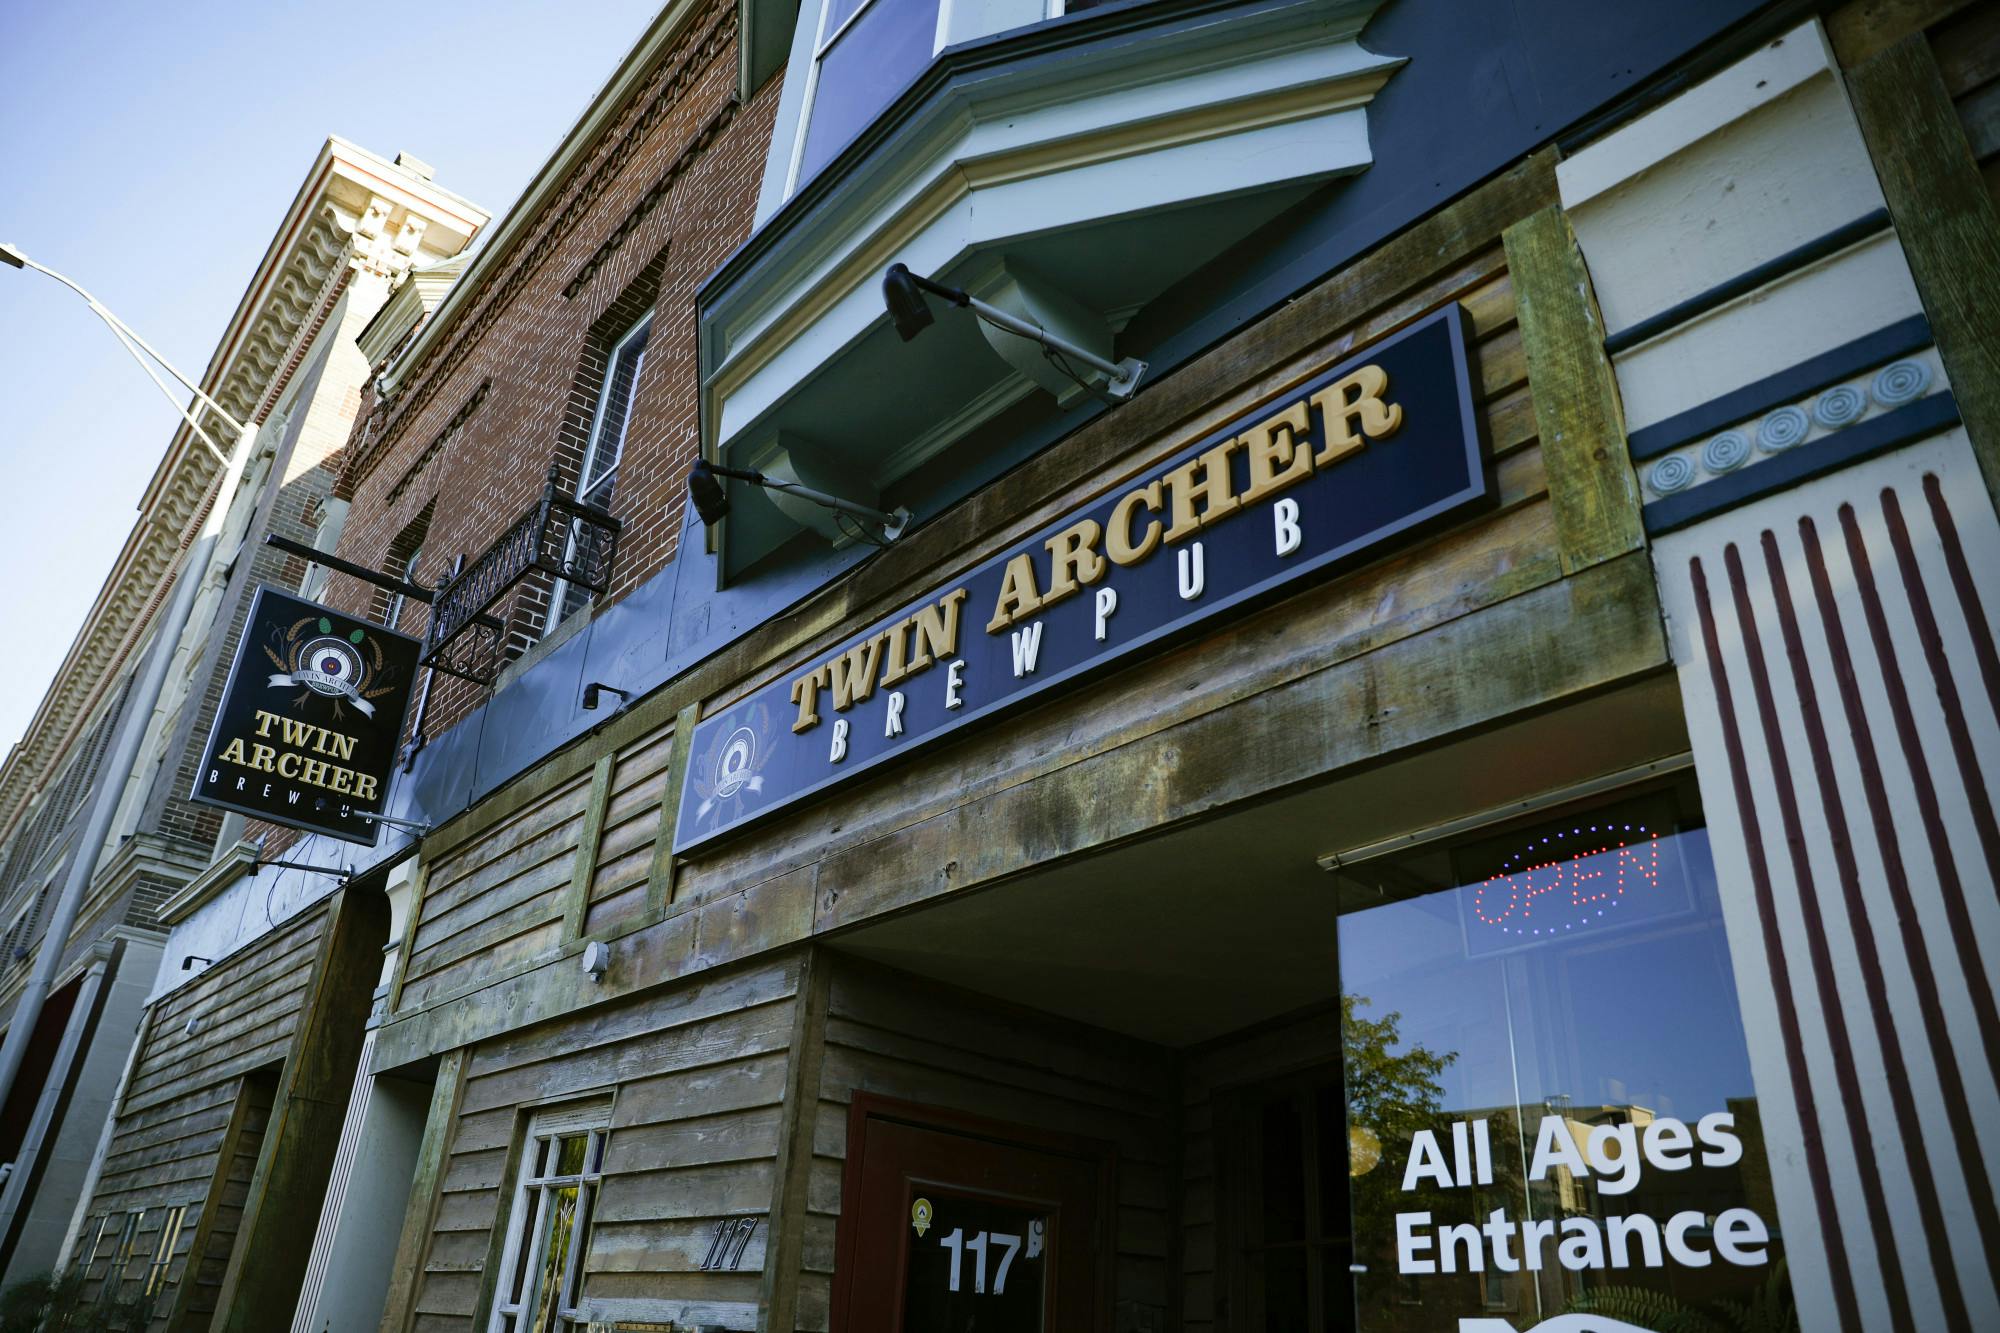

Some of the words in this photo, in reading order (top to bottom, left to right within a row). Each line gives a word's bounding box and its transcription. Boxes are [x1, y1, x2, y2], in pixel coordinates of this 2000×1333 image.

[790, 588, 967, 735] TWIN
[985, 364, 1402, 636] ARCHER
[255, 709, 358, 760] TWIN
[218, 737, 378, 801] ARCHER
[1475, 832, 1657, 924] OPEN
[1401, 1119, 1493, 1191] All
[1529, 1111, 1744, 1196] Ages
[700, 1216, 760, 1271] 117
[940, 1227, 1022, 1296] 117
[1395, 1207, 1770, 1274] Entrance
